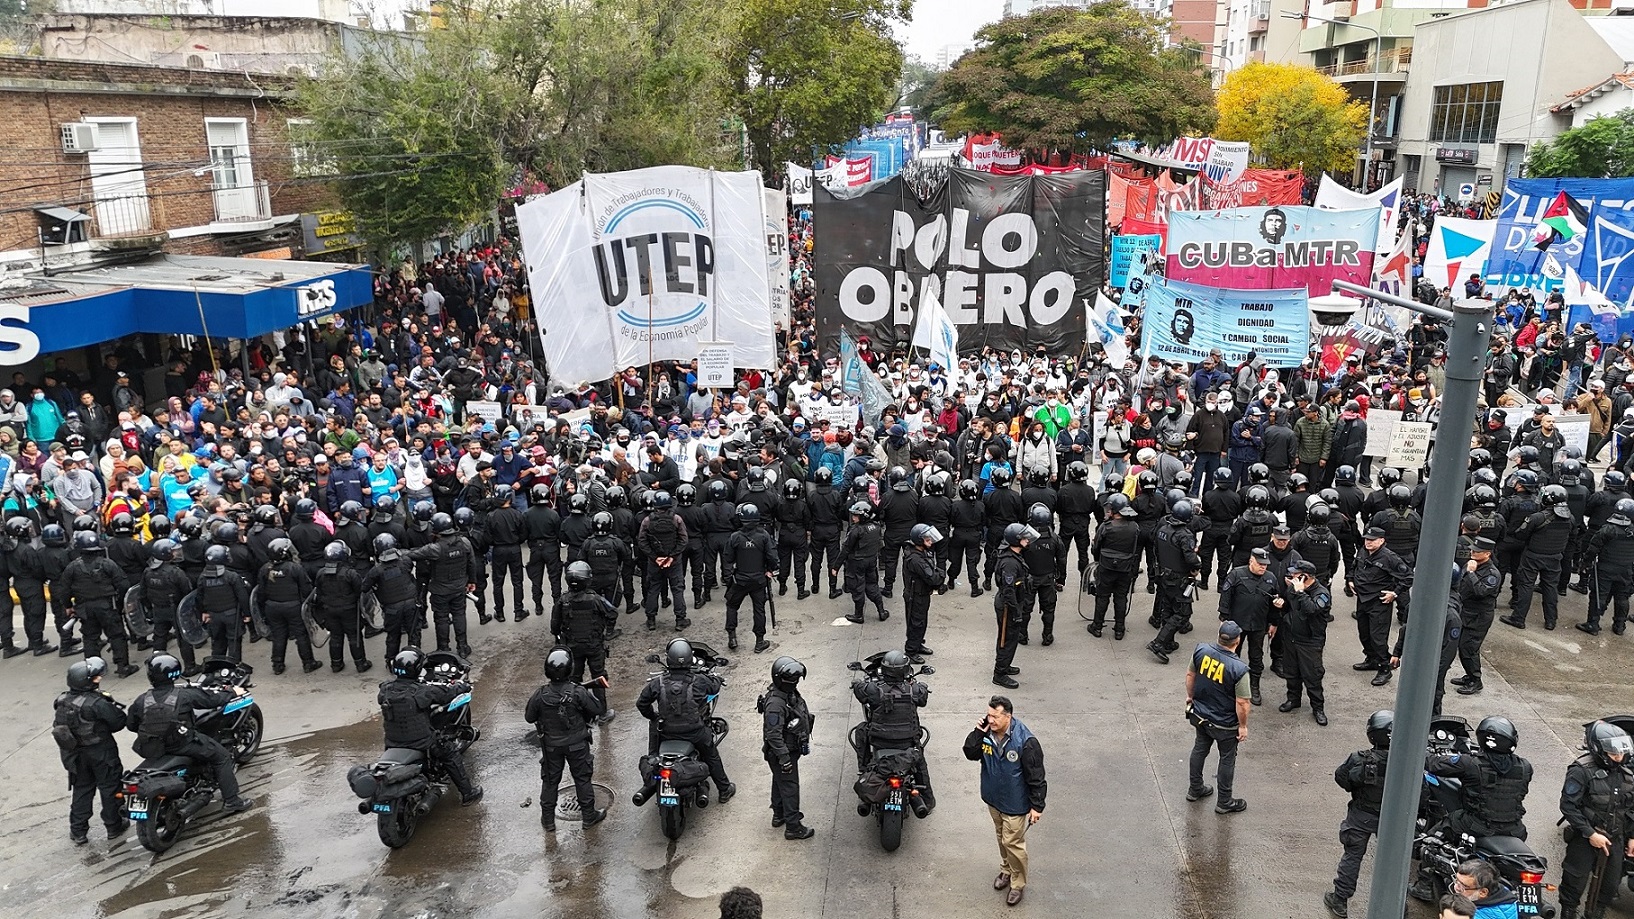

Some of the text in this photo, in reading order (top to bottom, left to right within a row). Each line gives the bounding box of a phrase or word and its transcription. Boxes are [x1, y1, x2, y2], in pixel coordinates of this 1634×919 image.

[1212, 158, 1234, 166] TRABAJO
[605, 204, 615, 216] de
[611, 187, 665, 207] Trabajadores
[668, 188, 674, 197] y
[889, 207, 1038, 270] POLO
[1178, 241, 1277, 267] CUBa
[1283, 239, 1359, 266] MTR
[591, 231, 714, 307] UTEP
[839, 267, 1077, 329] OBRERO
[1174, 298, 1193, 309] MTR
[1240, 302, 1274, 312] TRABAJO
[1237, 318, 1275, 327] DIGNIDAD
[620, 316, 709, 341] de la Economía Popular
[1228, 334, 1258, 344] CAMBIO
[1262, 334, 1290, 344] SOCIAL
[1158, 344, 1164, 352] 12
[1165, 345, 1171, 353] DE
[1172, 346, 1190, 355] ABRIL
[673, 454, 689, 463] UTEP
[1199, 655, 1225, 684] PFA
[981, 744, 993, 755] PFA
[661, 797, 678, 805] PFA
[1522, 887, 1536, 895] 791
[1522, 894, 1538, 903] ETM
[1518, 905, 1538, 913] PFA
